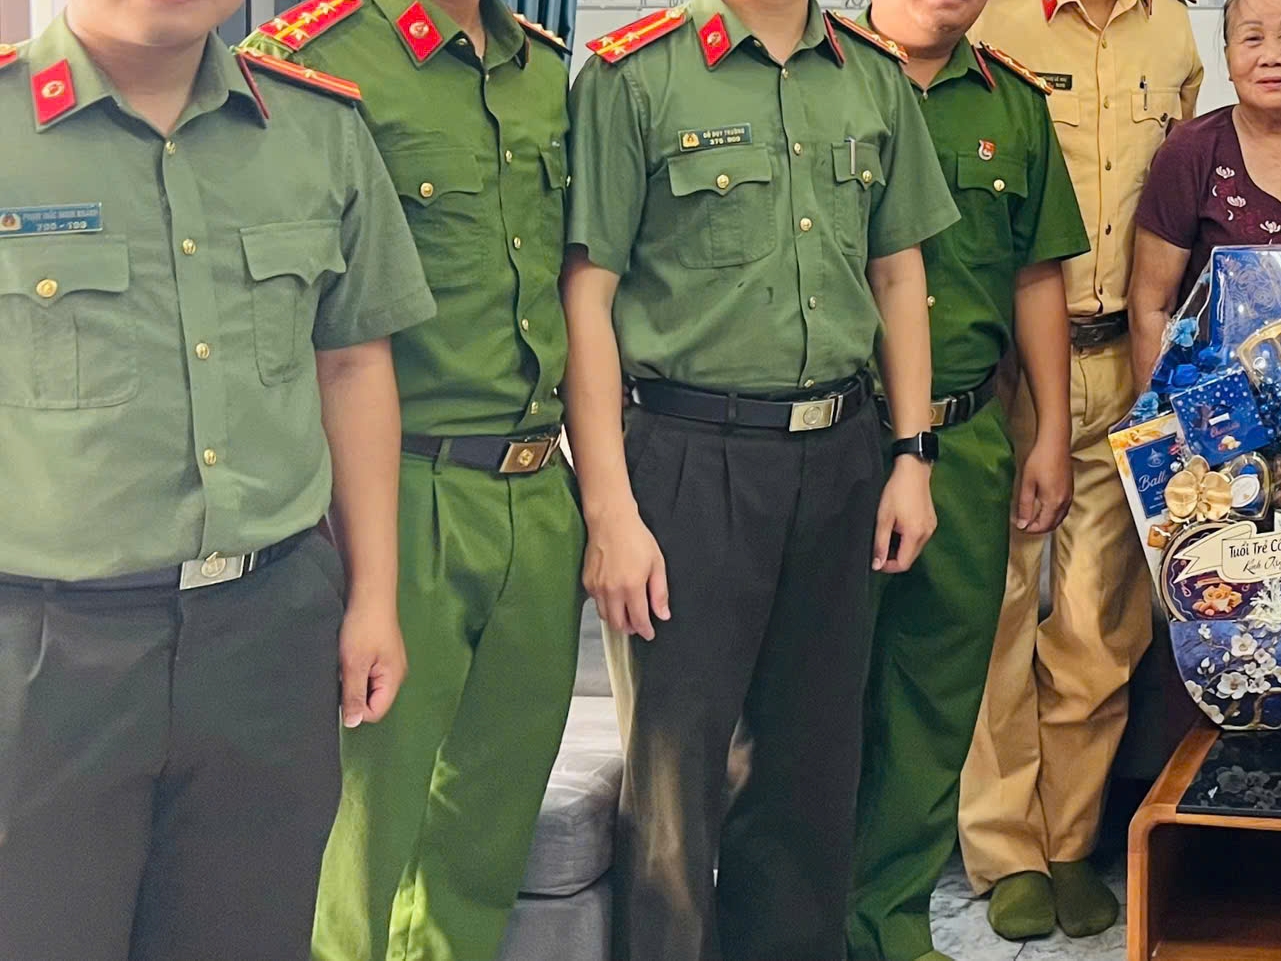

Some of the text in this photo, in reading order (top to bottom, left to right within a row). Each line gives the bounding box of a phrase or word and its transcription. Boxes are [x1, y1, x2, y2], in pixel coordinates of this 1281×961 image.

[1138, 469, 1168, 492] Ball
[1229, 541, 1249, 558] Tuổi
[1252, 540, 1268, 554] Trẻ
